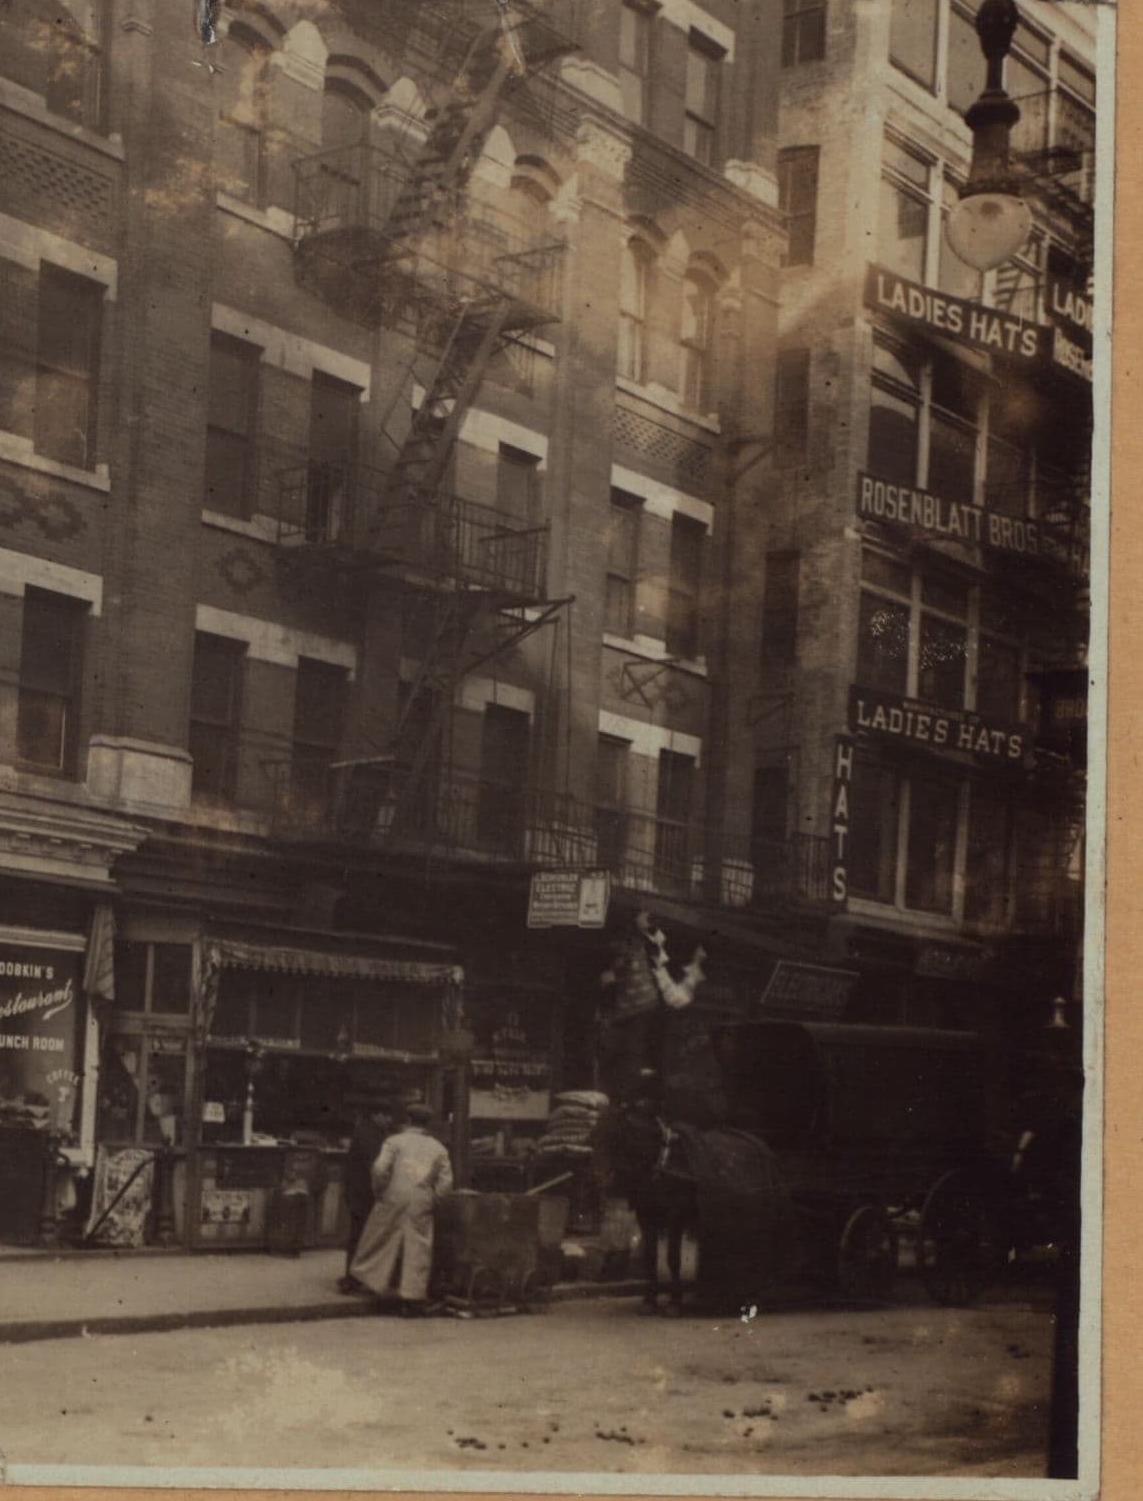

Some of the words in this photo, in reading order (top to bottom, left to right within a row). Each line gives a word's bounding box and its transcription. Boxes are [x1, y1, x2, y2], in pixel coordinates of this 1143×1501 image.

[877, 275, 963, 334] LADIES
[969, 309, 1038, 357] HATS
[861, 478, 982, 541] ROSENBLATT
[857, 700, 949, 743] LADIES
[957, 723, 1023, 758] HATS
[833, 743, 853, 900] HATS
[32, 1036, 65, 1052] ROOM
